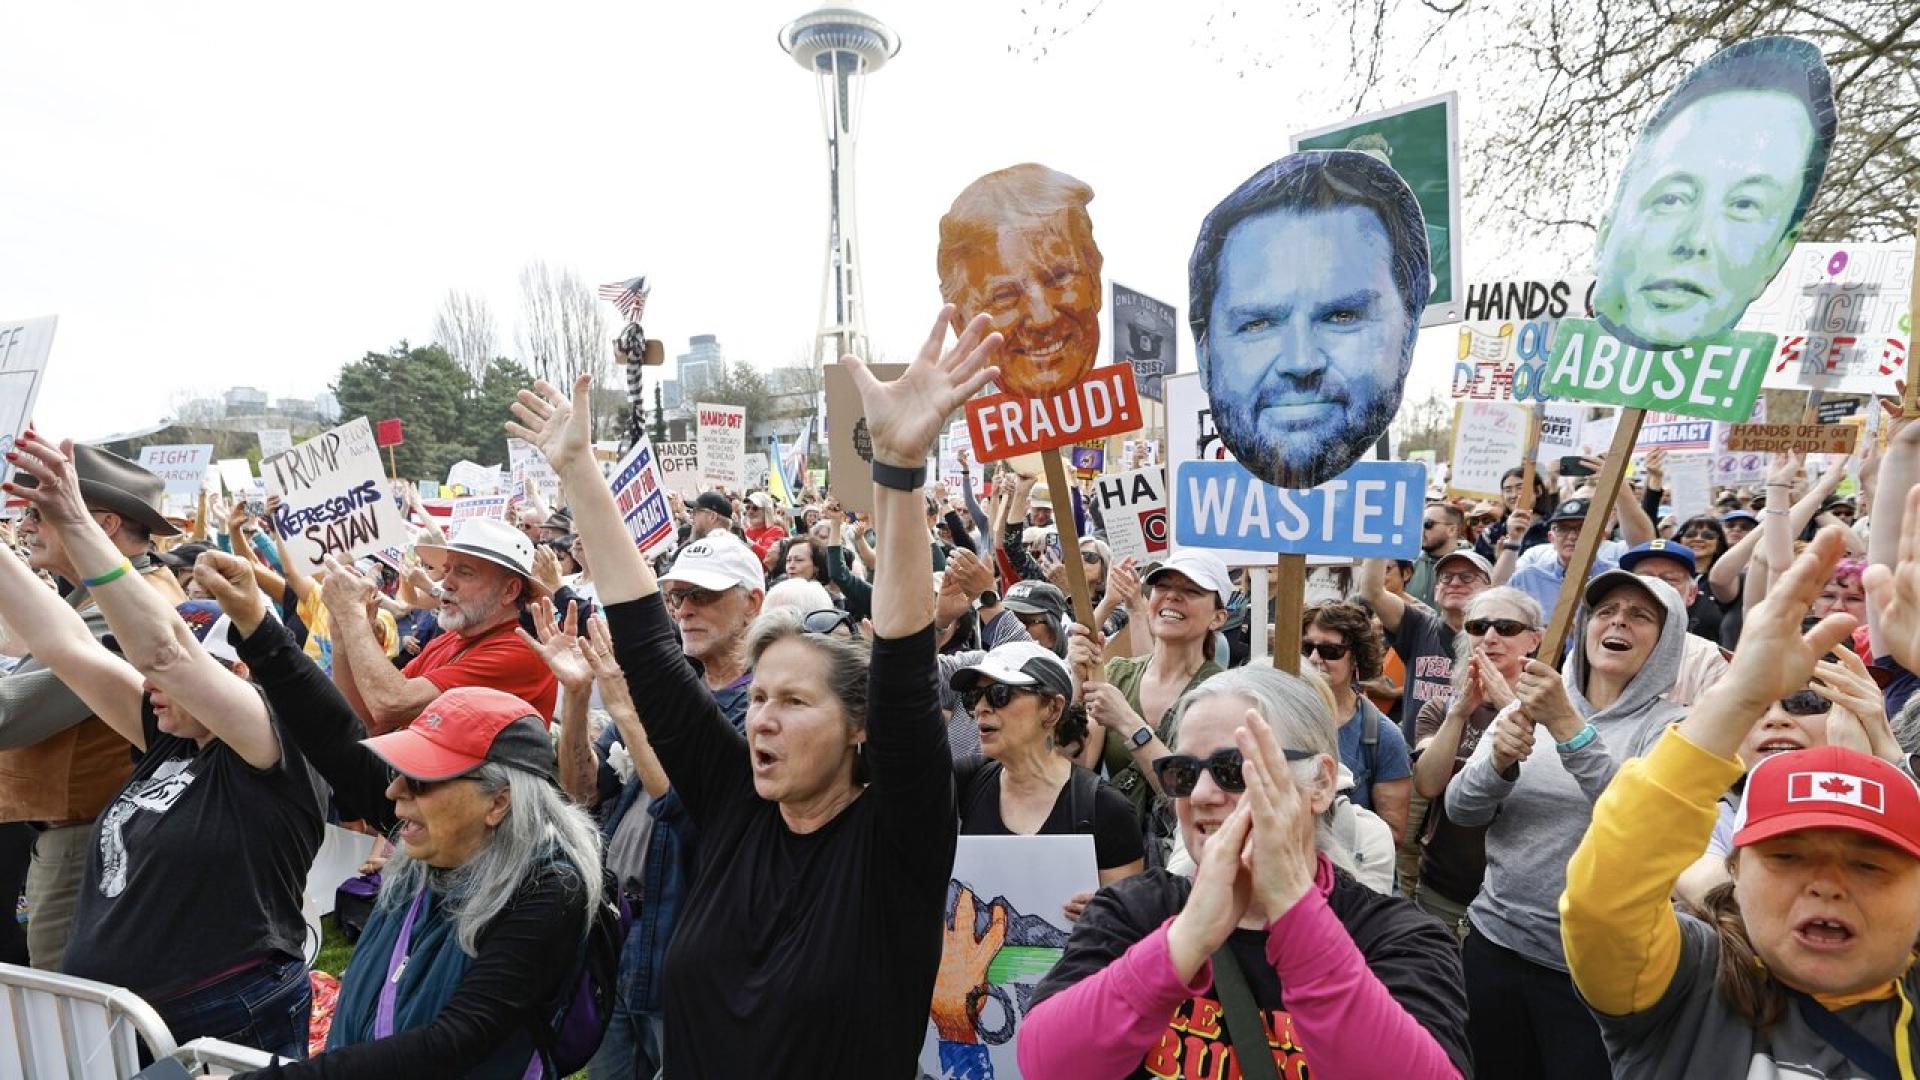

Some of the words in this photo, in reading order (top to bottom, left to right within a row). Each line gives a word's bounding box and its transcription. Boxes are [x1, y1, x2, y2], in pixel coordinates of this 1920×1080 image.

[1116, 294, 1138, 306] ONLY
[1141, 299, 1157, 313] YOU
[1465, 281, 1570, 320] HANDS
[1130, 360, 1164, 377] ESIST
[1551, 333, 1752, 408] ABUSE!
[977, 374, 1129, 452] FRAUD!
[1542, 423, 1571, 437] OFF!
[1735, 424, 1791, 437] HANDS
[1796, 425, 1824, 438] OFF
[149, 449, 200, 465] FIGHT
[657, 443, 697, 456] HANDS
[1742, 438, 1826, 452] MEDICAID!
[263, 432, 340, 496] TRUMP
[274, 480, 382, 542] REPRESENTS
[1188, 476, 1407, 545] WASTE!
[305, 503, 379, 565] SATAN
